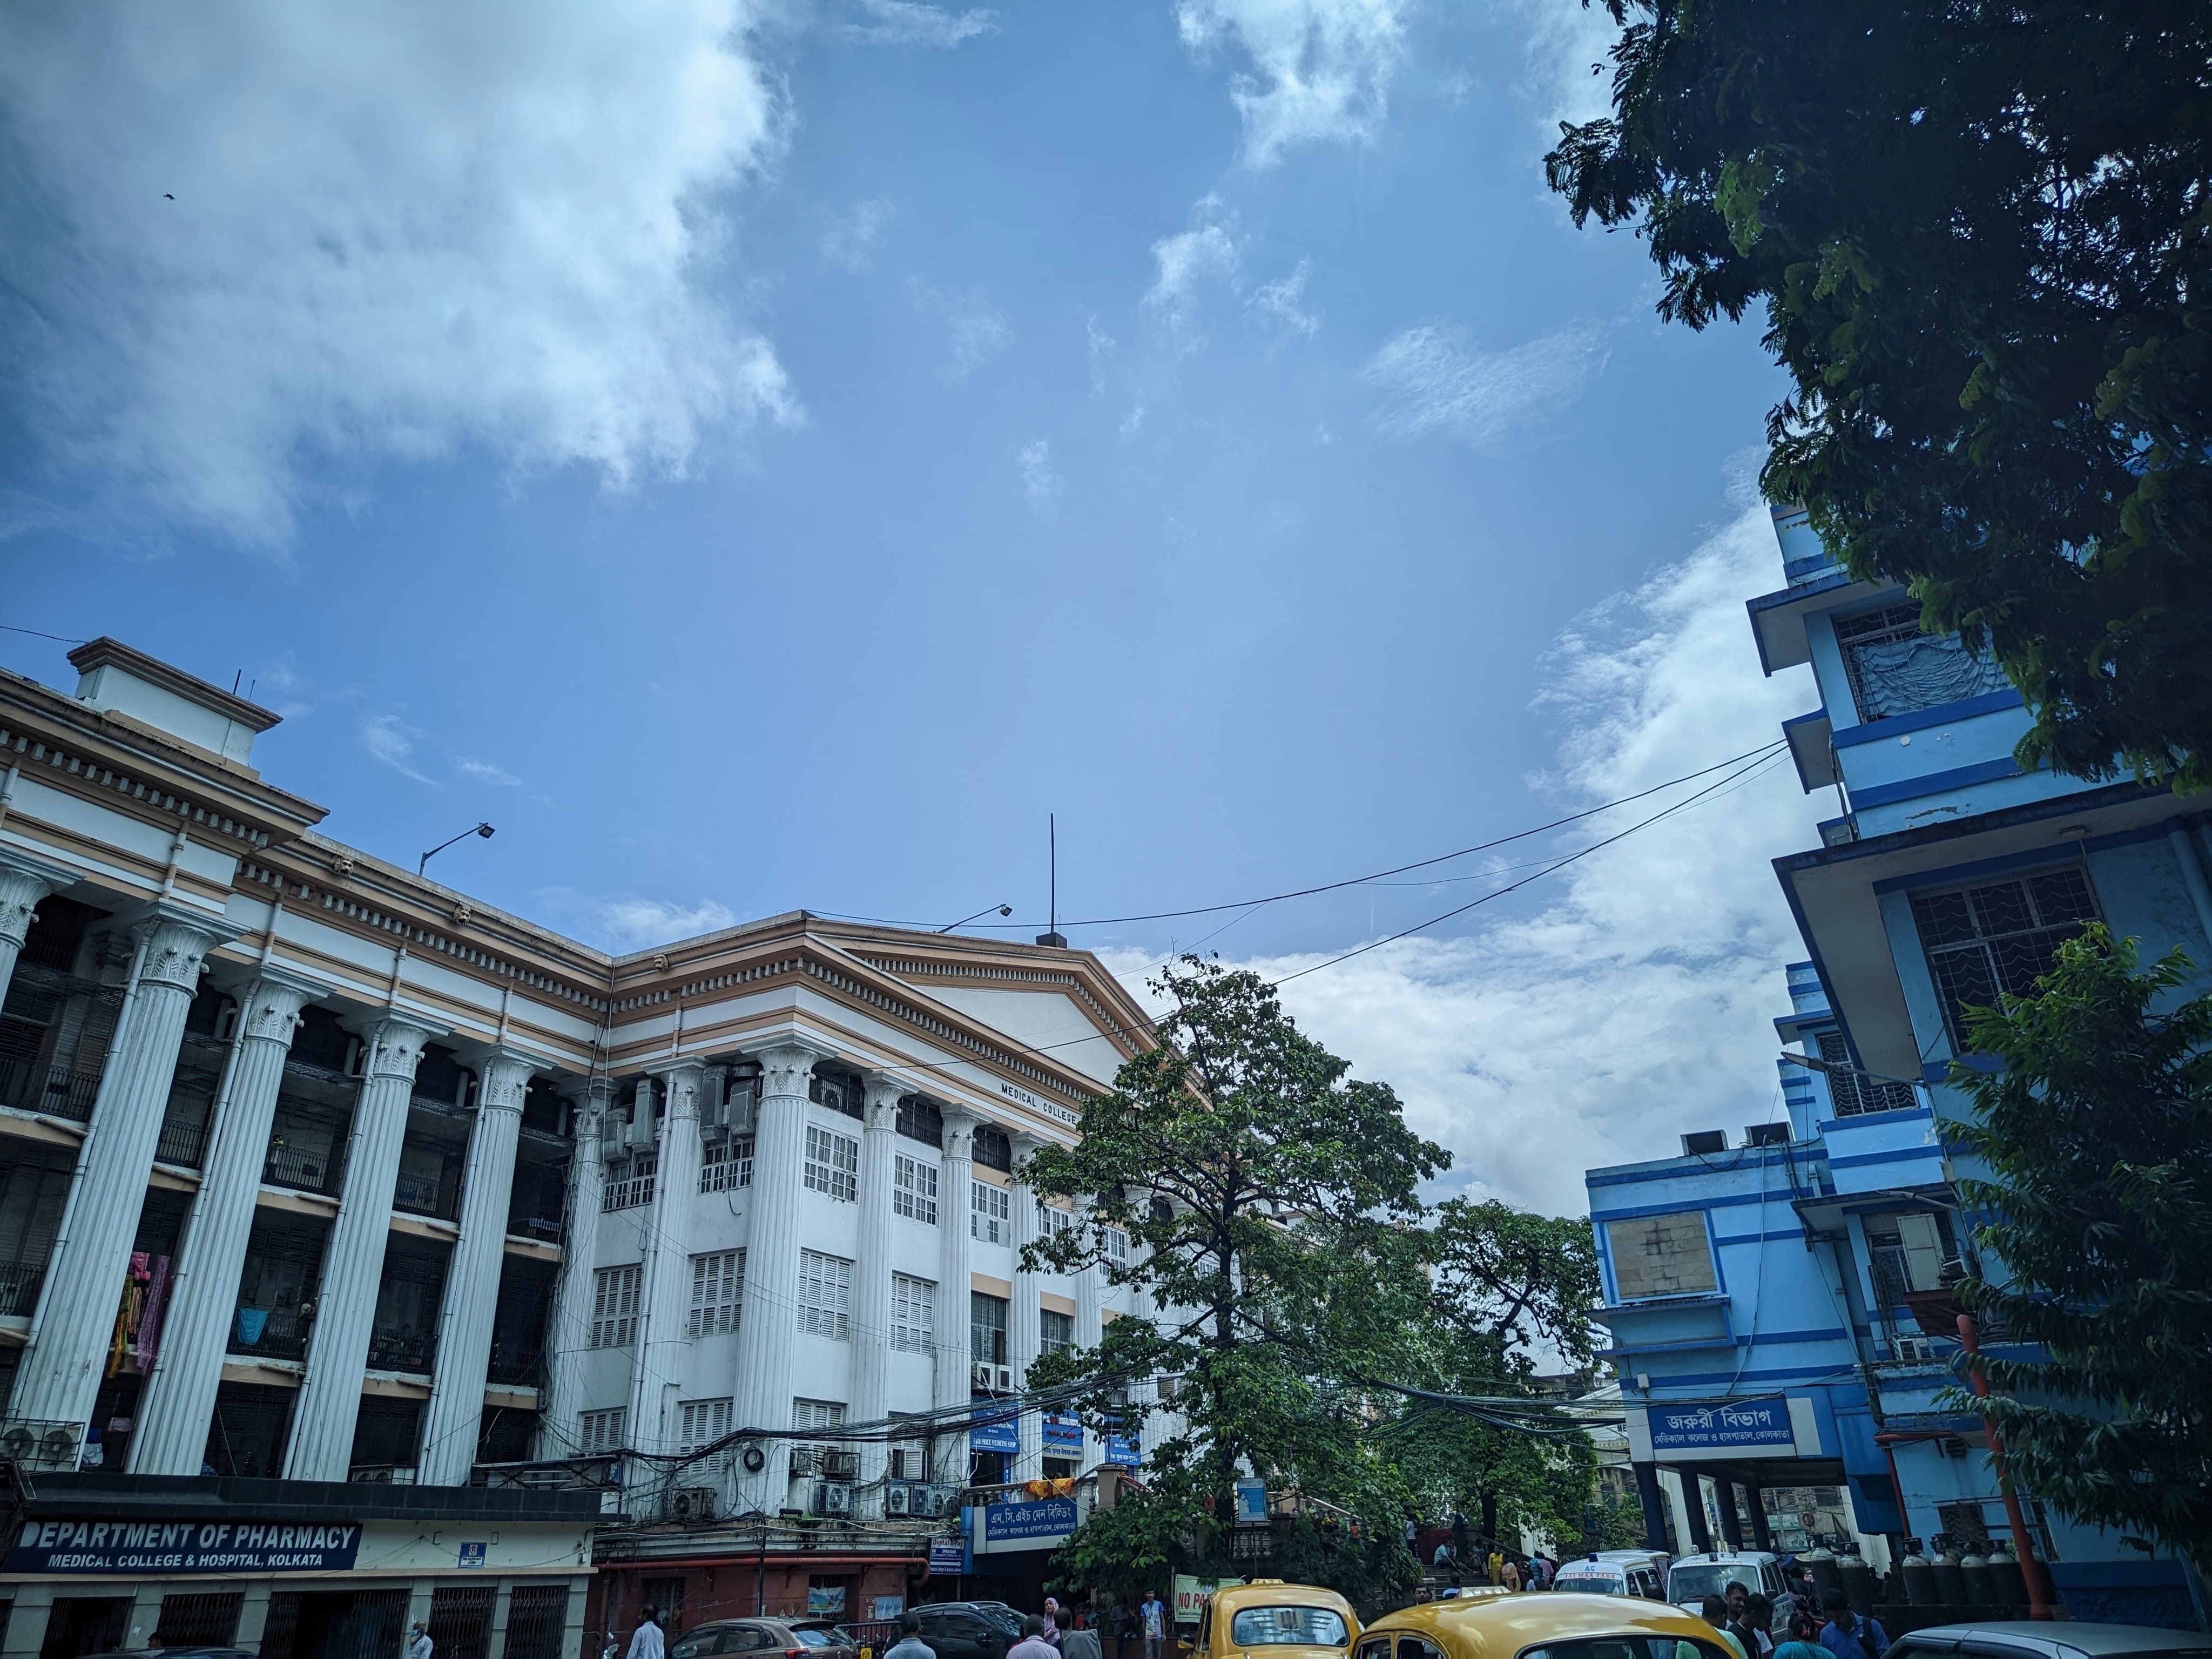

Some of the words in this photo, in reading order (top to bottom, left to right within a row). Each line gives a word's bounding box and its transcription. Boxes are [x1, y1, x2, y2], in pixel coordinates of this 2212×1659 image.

[1001, 1083, 1037, 1108] MEDICAL
[1043, 1103, 1076, 1125] COLLEGE
[1665, 1408, 1714, 1430] জরুরী
[1720, 1408, 1772, 1427] বিভাগ
[992, 1439, 1007, 1447] MEDICINE
[1654, 1432, 1685, 1444] মেডিক্যাল
[1687, 1433, 1709, 1443] কলেজ
[1756, 1430, 1790, 1441] কোলকাতা
[1016, 1507, 1031, 1522] এইচ
[1033, 1509, 1046, 1521] মেন
[1047, 1503, 1072, 1520] বিল্ডিং
[19, 1521, 195, 1548] DEPARTMENT
[199, 1524, 231, 1548] OF
[234, 1525, 355, 1549] PHARMACY
[988, 1527, 1008, 1536] মেডিক্যাল
[1009, 1527, 1023, 1535] কলেজ
[1054, 1522, 1076, 1532] কোলকাতা
[933, 1539, 949, 1547] Digital
[48, 1554, 113, 1567] MEDICAL
[118, 1555, 183, 1567] COLLEGE
[185, 1555, 194, 1566] &
[199, 1554, 264, 1568] HOSPITAL,
[268, 1554, 322, 1566] KOLKATA
[1178, 1591, 1190, 1609] NO
